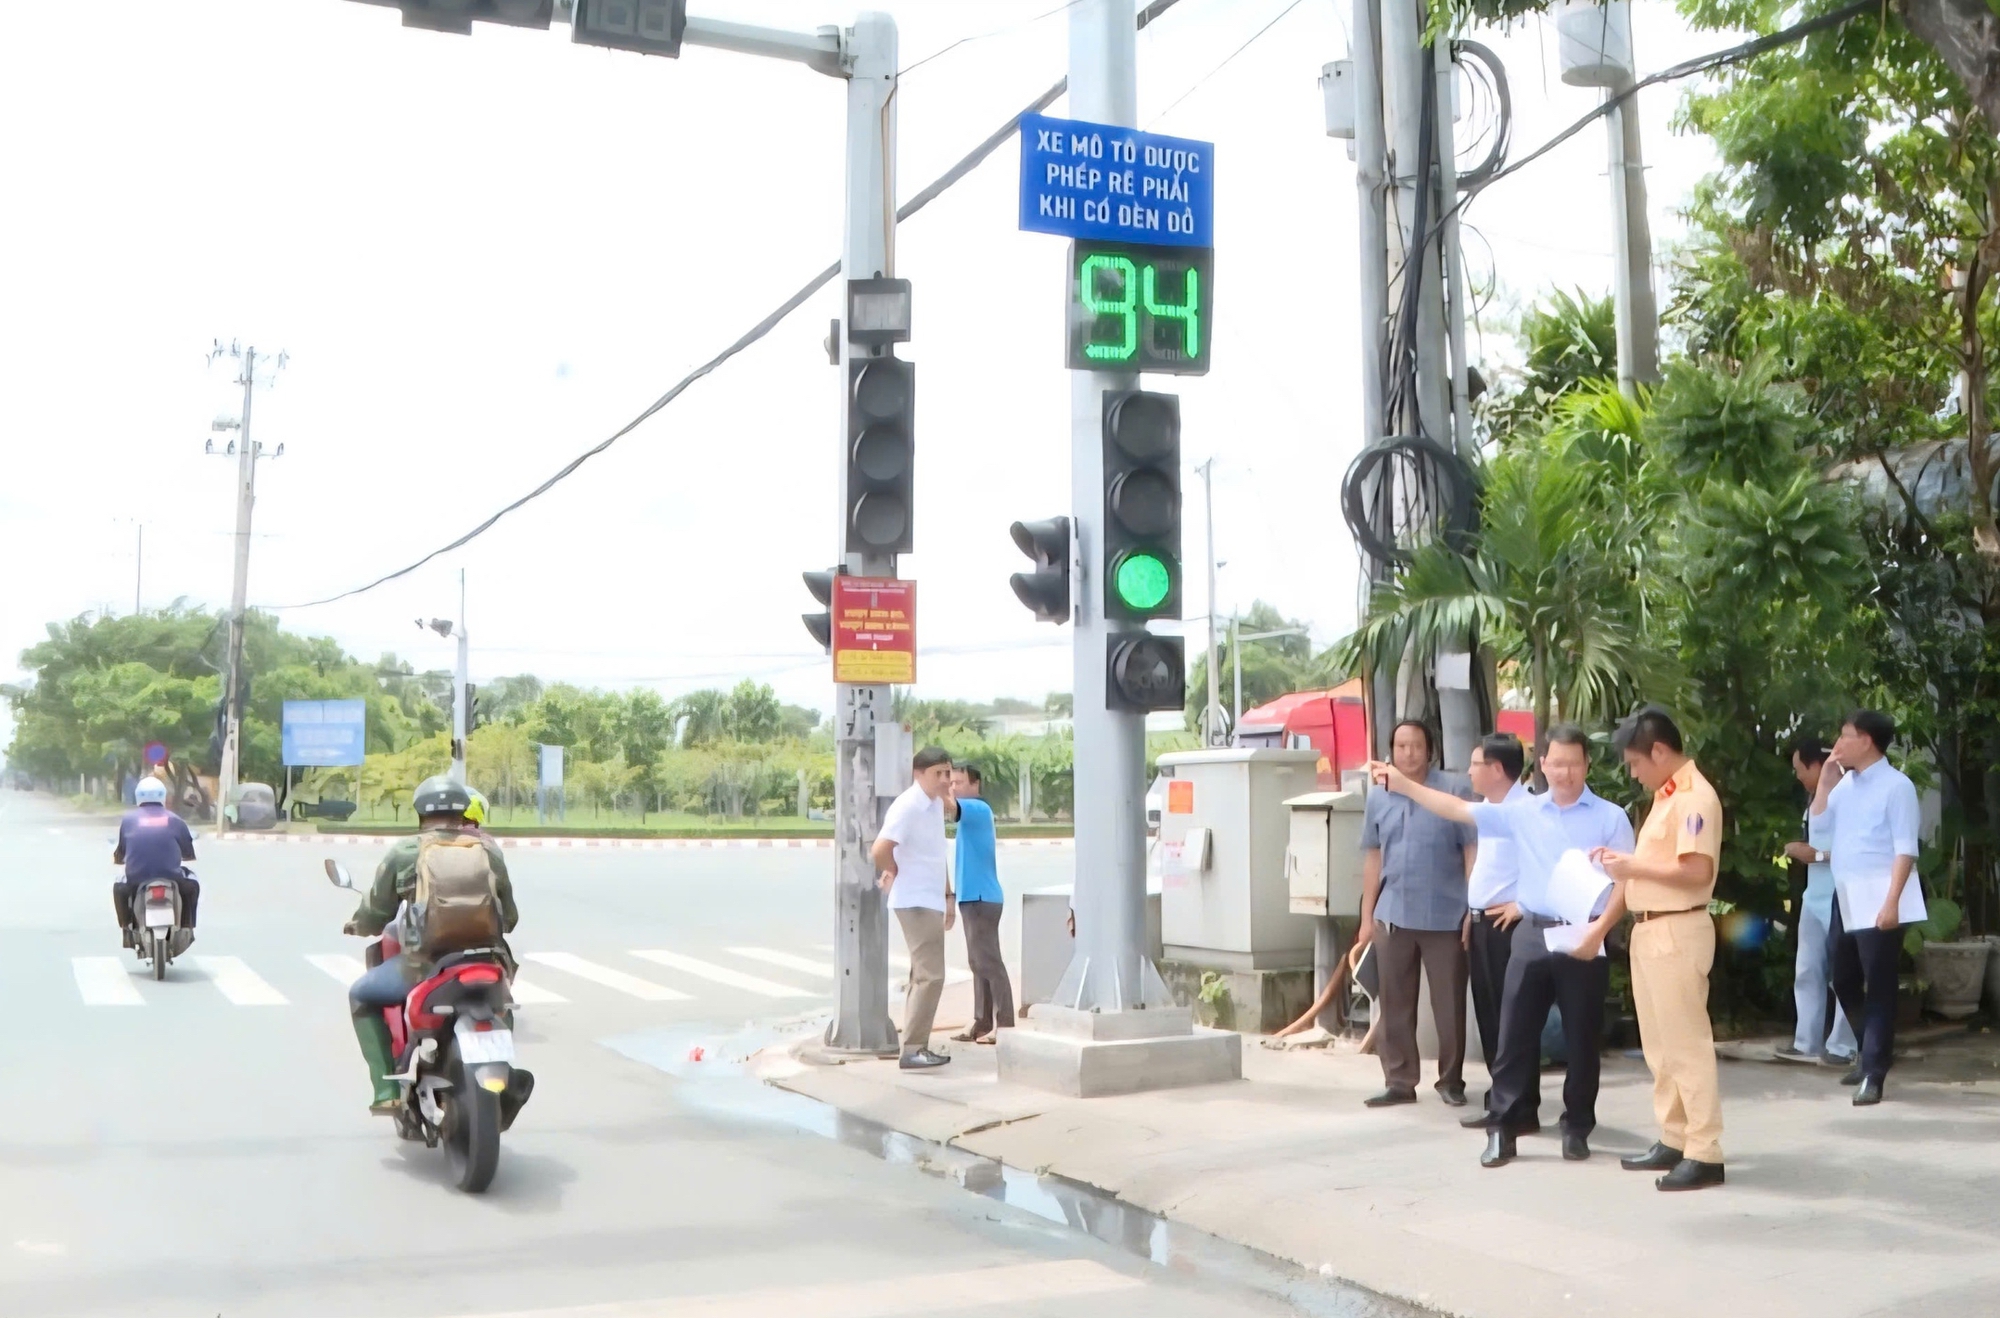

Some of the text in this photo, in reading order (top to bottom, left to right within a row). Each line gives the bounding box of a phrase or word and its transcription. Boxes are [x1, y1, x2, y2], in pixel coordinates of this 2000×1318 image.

[1037, 129, 1063, 154] XE
[1071, 133, 1103, 159] MÔ
[1111, 138, 1136, 163] TÔ
[1047, 162, 1101, 190] PHÉP
[1039, 195, 1075, 220] KHI
[1083, 196, 1110, 224] CÓ
[1080, 254, 1198, 359] 94
